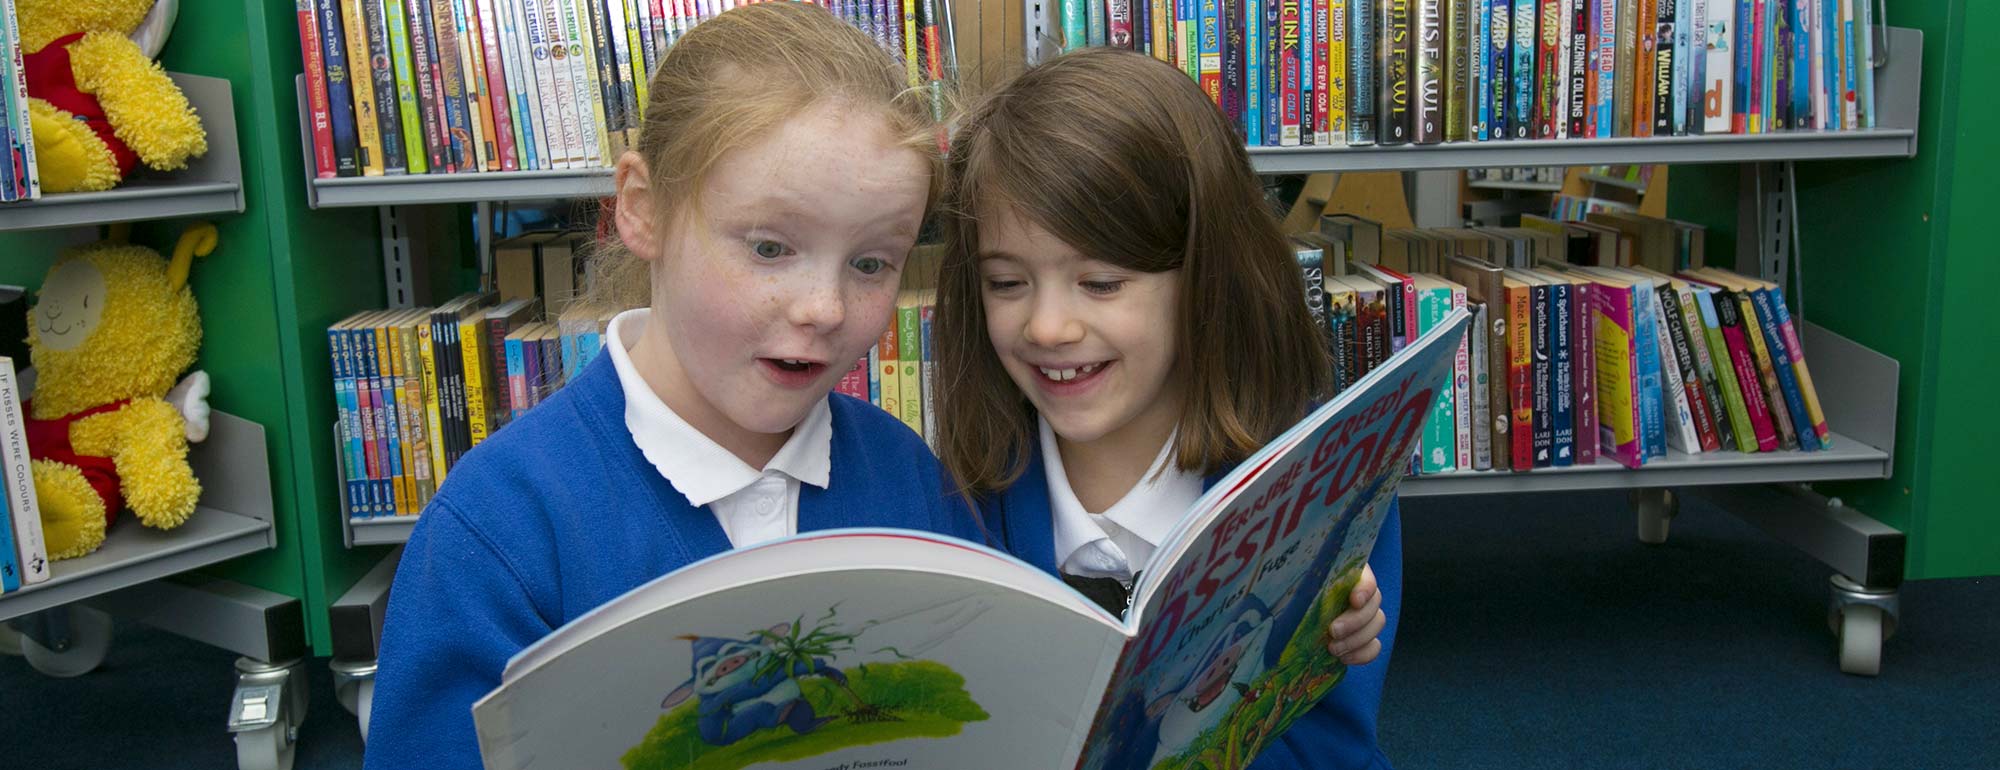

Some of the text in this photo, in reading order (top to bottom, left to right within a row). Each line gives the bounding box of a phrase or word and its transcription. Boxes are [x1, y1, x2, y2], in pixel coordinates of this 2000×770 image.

[1575, 0, 1582, 9] ER
[305, 14, 315, 39] Down
[1204, 16, 1216, 49] BOLDS
[1284, 20, 1298, 51] INK
[1317, 8, 1327, 44] MUMMY
[1333, 7, 1344, 42] MUMMY
[1492, 5, 1507, 49] WARP
[1516, 3, 1533, 48] WARP
[1543, 2, 1558, 47] WARP
[1625, 28, 1636, 55] Hitler
[8, 13, 18, 41] Scottish
[13, 42, 22, 66] Things
[20, 87, 27, 98] Go
[329, 38, 338, 56] Troll
[1602, 47, 1614, 72] HEAD
[415, 36, 432, 99] OTHERS SLEEP
[1496, 69, 1504, 98] FOREVER
[1573, 34, 1585, 118] SUZANNE COLLINS
[1658, 49, 1671, 96] WILLIAM
[313, 79, 322, 108] Stream
[1287, 57, 1296, 120] STEVE COLE
[1318, 92, 1326, 113] COLE
[315, 112, 326, 131] B.B.
[539, 79, 558, 150] BLACK CLARE
[557, 77, 574, 150] BLACK CLARE
[575, 75, 592, 146] BLACK CLARE
[24, 127, 34, 163] McLelland
[428, 122, 438, 147] BECKER
[1373, 319, 1381, 335] THE
[1536, 288, 1546, 350] 2 Spellchasers
[1557, 286, 1567, 346] 3 Spellchasers
[1681, 292, 1697, 328] ELEVEN
[1777, 304, 1789, 322] Fish
[463, 329, 476, 353] Judy
[884, 331, 894, 356] Blyton
[904, 311, 914, 356] Enid Blyton
[1345, 320, 1355, 371] THE HISTORY
[1514, 295, 1527, 363] Maze Running
[1661, 289, 1677, 319] WOLF
[1670, 321, 1691, 371] CHILDREN
[332, 353, 343, 376] QUEST
[341, 352, 352, 375] QUEST
[356, 352, 366, 375] QUEST
[367, 352, 377, 374] QUEST
[1337, 323, 1346, 380] NIGHTSHIP TO
[1691, 329, 1709, 365] ELEVEN
[465, 355, 478, 385] Blume
[840, 374, 850, 391] The
[851, 376, 861, 391] The
[1536, 362, 1541, 370] to
[1691, 384, 1700, 400] PAUL
[906, 399, 918, 423] Valley
[1, 373, 30, 513] IF KISSES WERE COLOURS
[1157, 554, 1202, 617] THE
[1205, 455, 1309, 567] TERRIBLE
[1310, 371, 1418, 473] GREEDY
[1124, 387, 1433, 677] OSSIFOO
[1177, 540, 1302, 651] Charles Fuge
